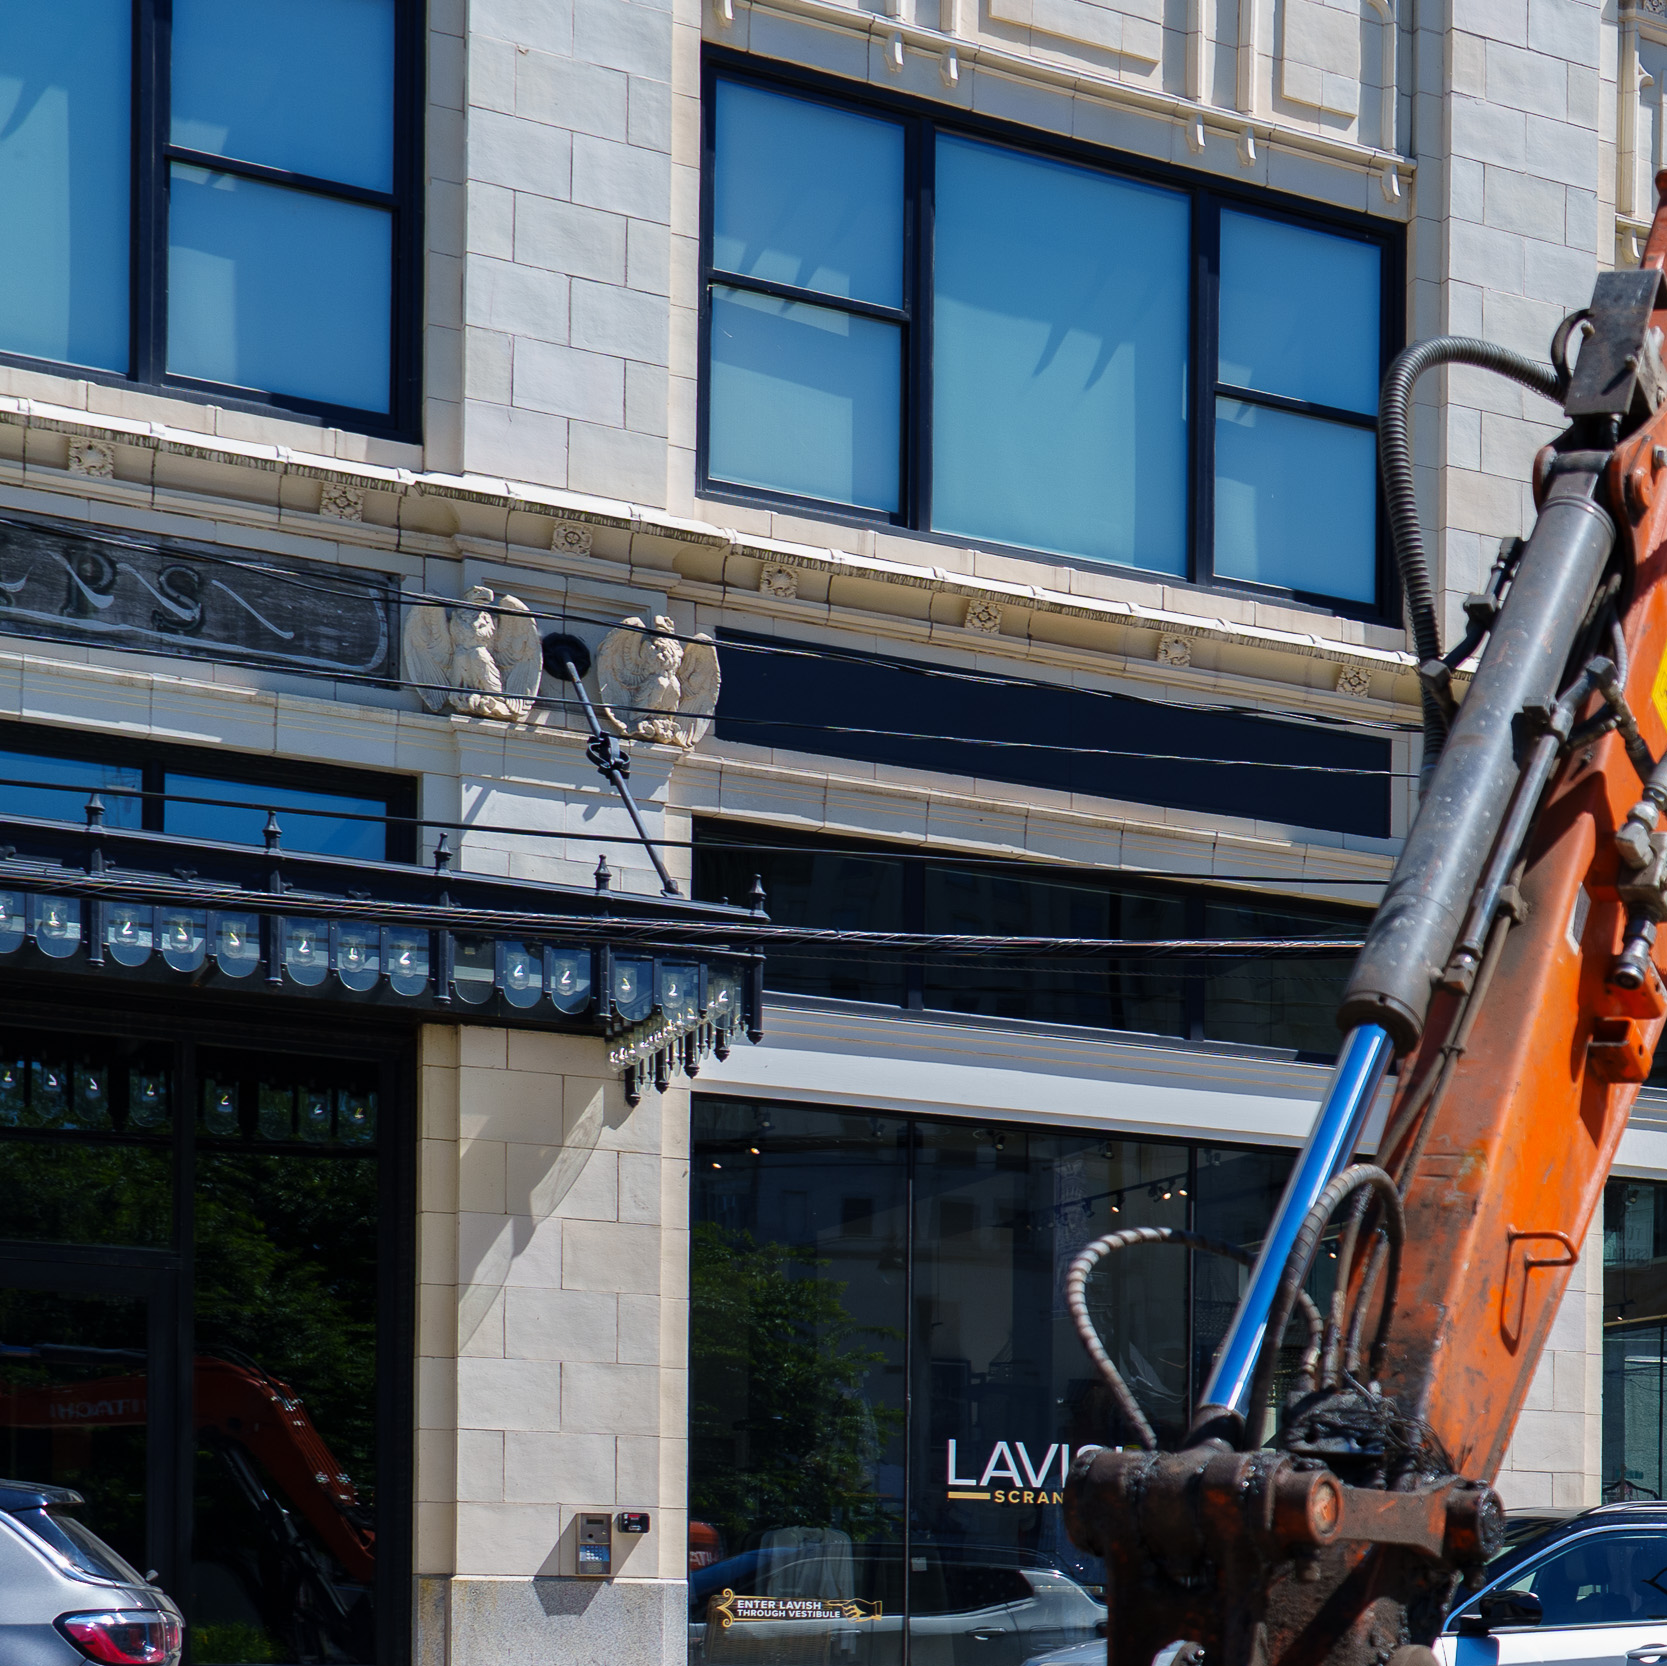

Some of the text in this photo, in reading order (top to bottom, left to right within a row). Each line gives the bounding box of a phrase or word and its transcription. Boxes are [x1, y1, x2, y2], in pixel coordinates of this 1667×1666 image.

[948, 1439, 1122, 1489] LAVI
[994, 1490, 1064, 1504] SCRAN
[737, 1600, 822, 1610] ENTER LAVISH
[737, 1609, 841, 1618] THROUGH VESTIBULE
